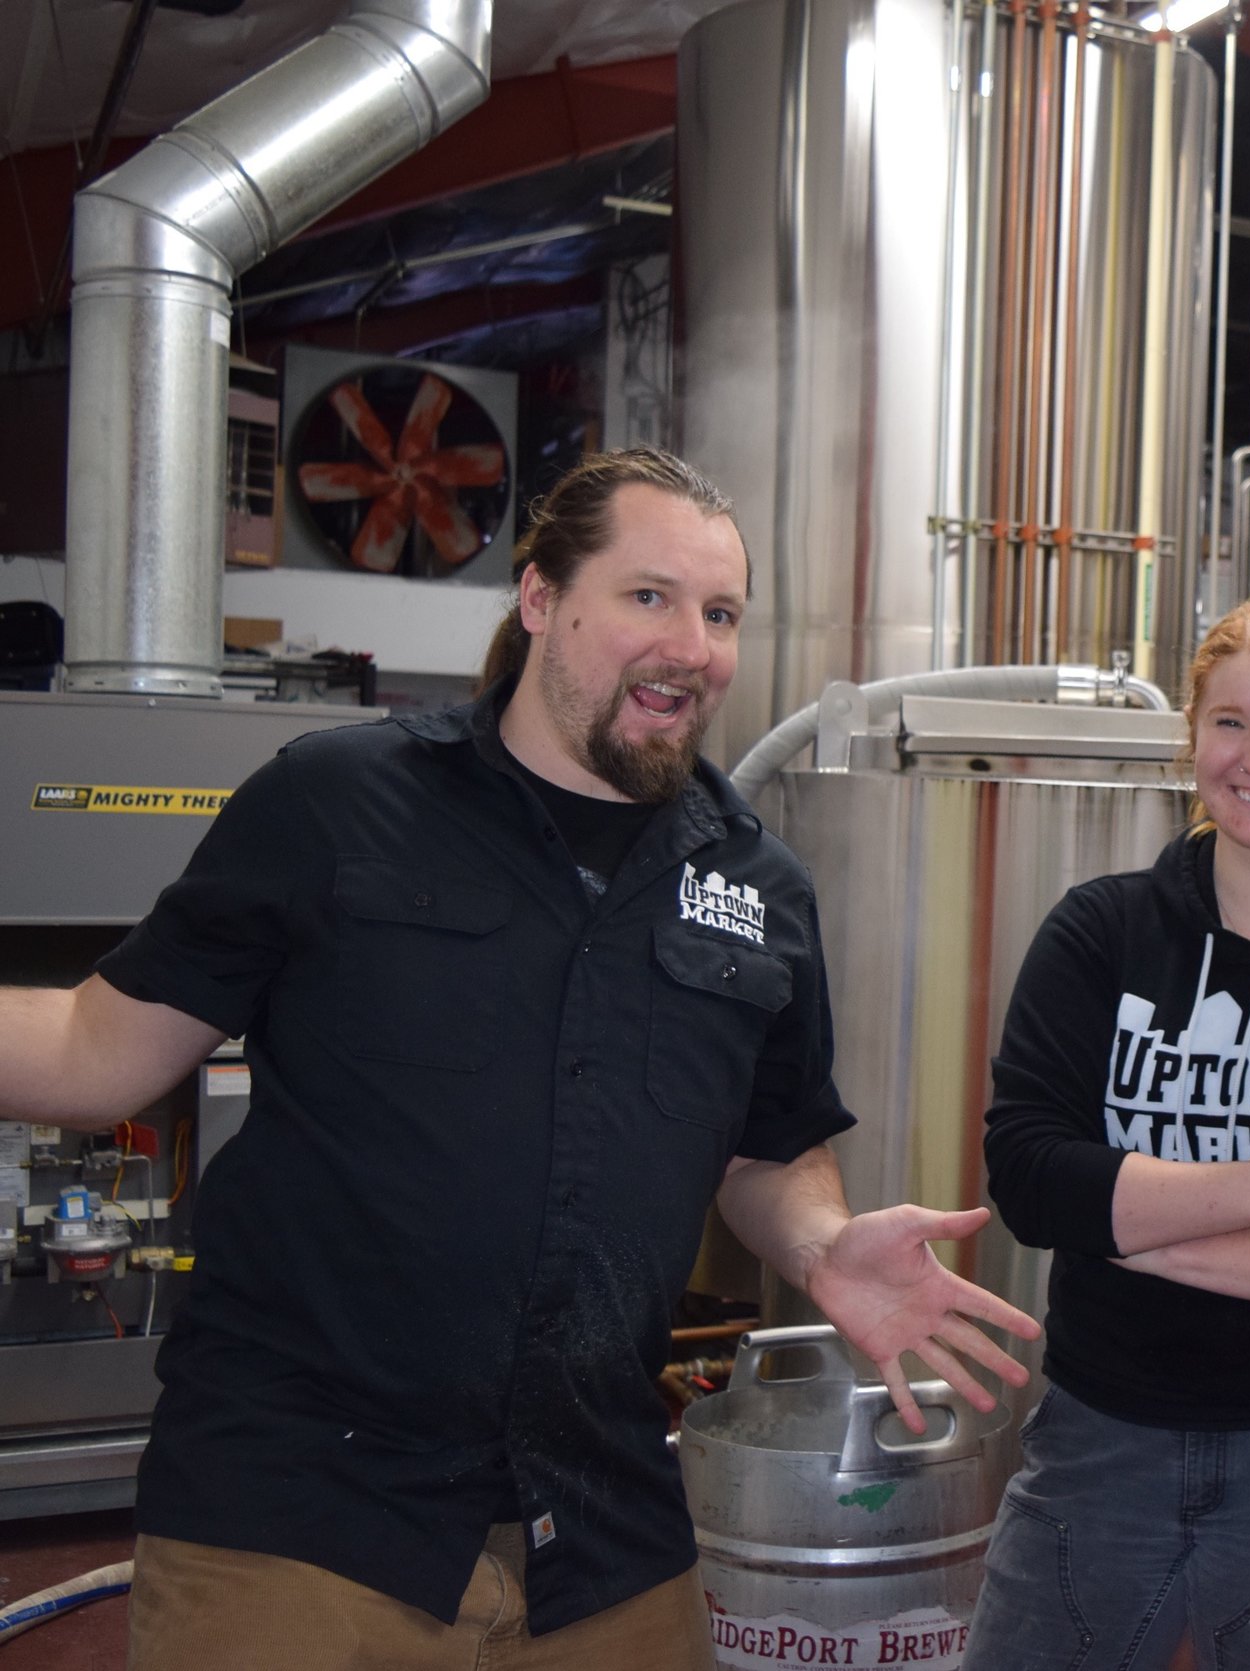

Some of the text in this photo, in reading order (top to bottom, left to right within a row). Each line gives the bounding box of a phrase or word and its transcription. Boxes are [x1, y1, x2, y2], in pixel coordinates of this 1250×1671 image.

[93, 792, 174, 808] MIGHTY
[680, 901, 765, 945] MARKET
[684, 875, 763, 926] UPTOWN
[710, 1617, 859, 1665] IDGEPORT
